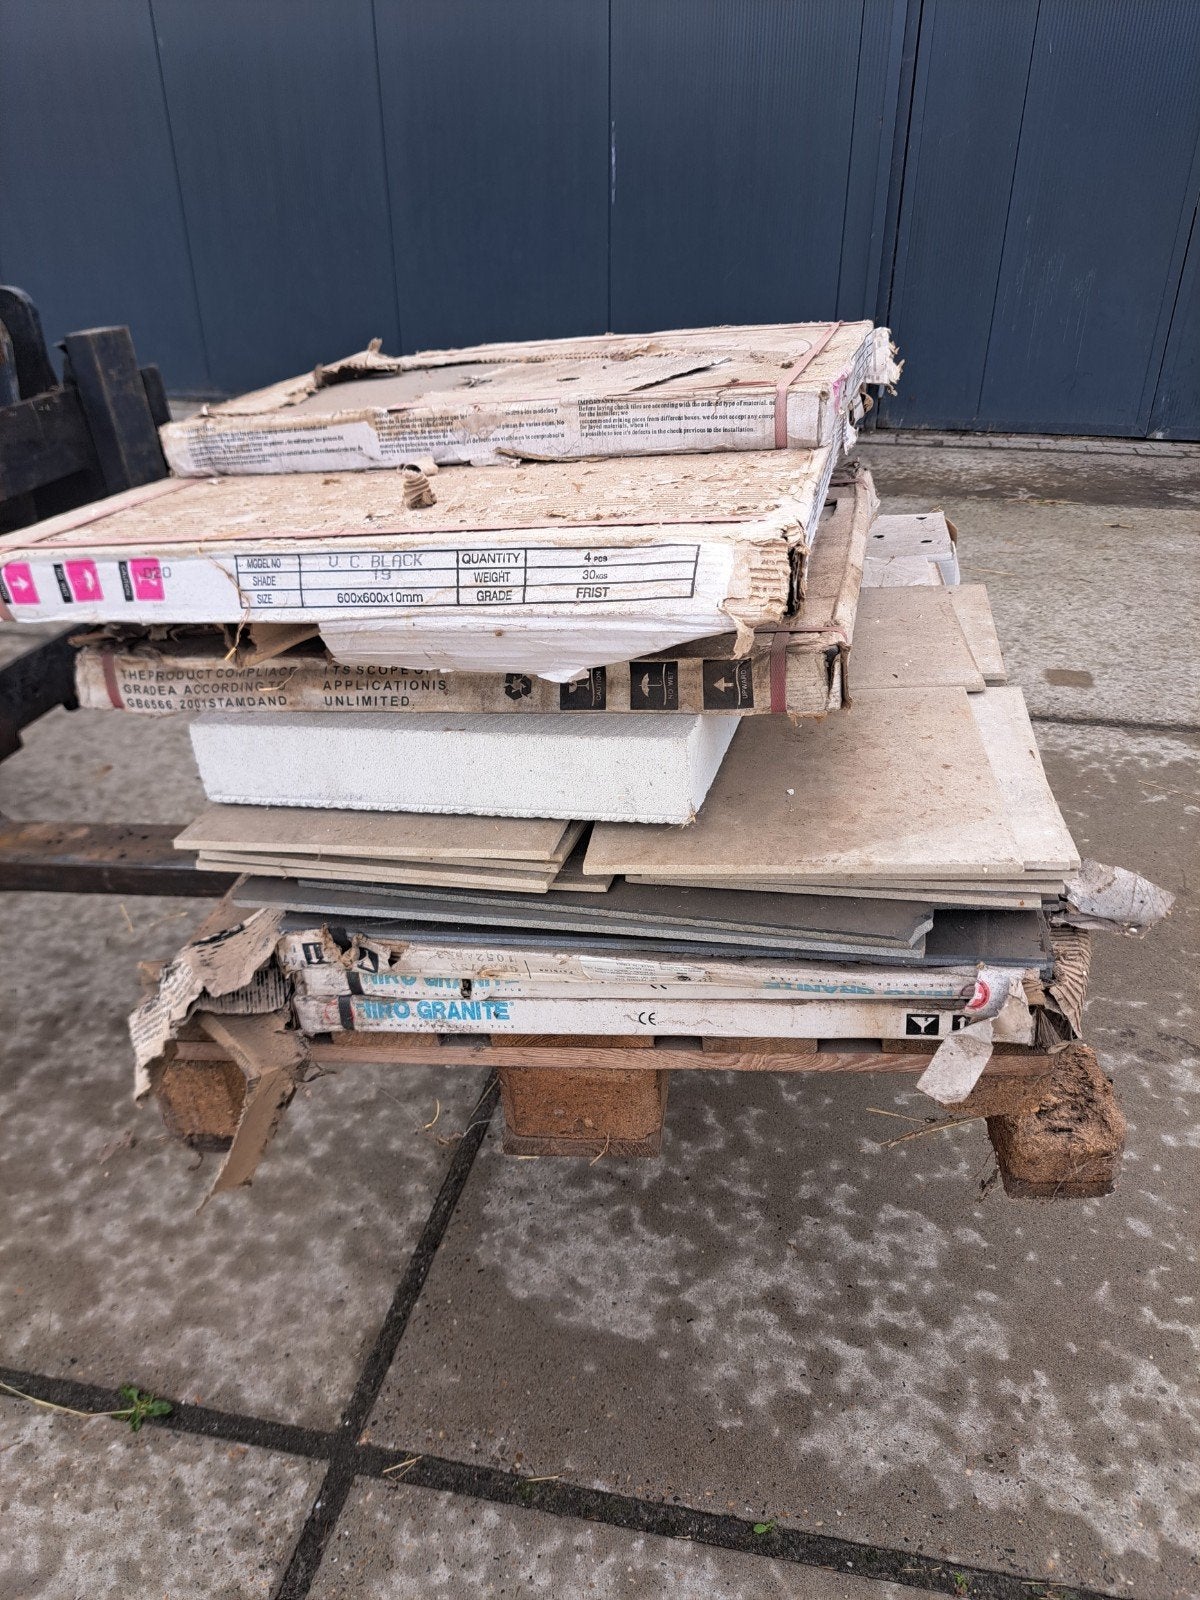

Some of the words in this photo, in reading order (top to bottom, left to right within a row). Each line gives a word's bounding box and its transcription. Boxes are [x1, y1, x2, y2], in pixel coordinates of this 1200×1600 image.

[247, 558, 270, 568] MODEL
[271, 558, 281, 568] NO
[371, 554, 423, 568] BLACK
[462, 553, 520, 564] QUANTITY
[253, 576, 276, 586] SHADE
[474, 572, 510, 583] WEIGHT
[337, 592, 423, 603] 600x600x10mm
[476, 590, 512, 601] GRADE
[576, 587, 610, 598] FRIST
[257, 594, 273, 604] SIZE
[184, 682, 264, 694] ACCORDING
[323, 680, 446, 690] APPLICATIONIS
[668, 689, 674, 699] NO
[417, 1001, 510, 1020] GRANITE
